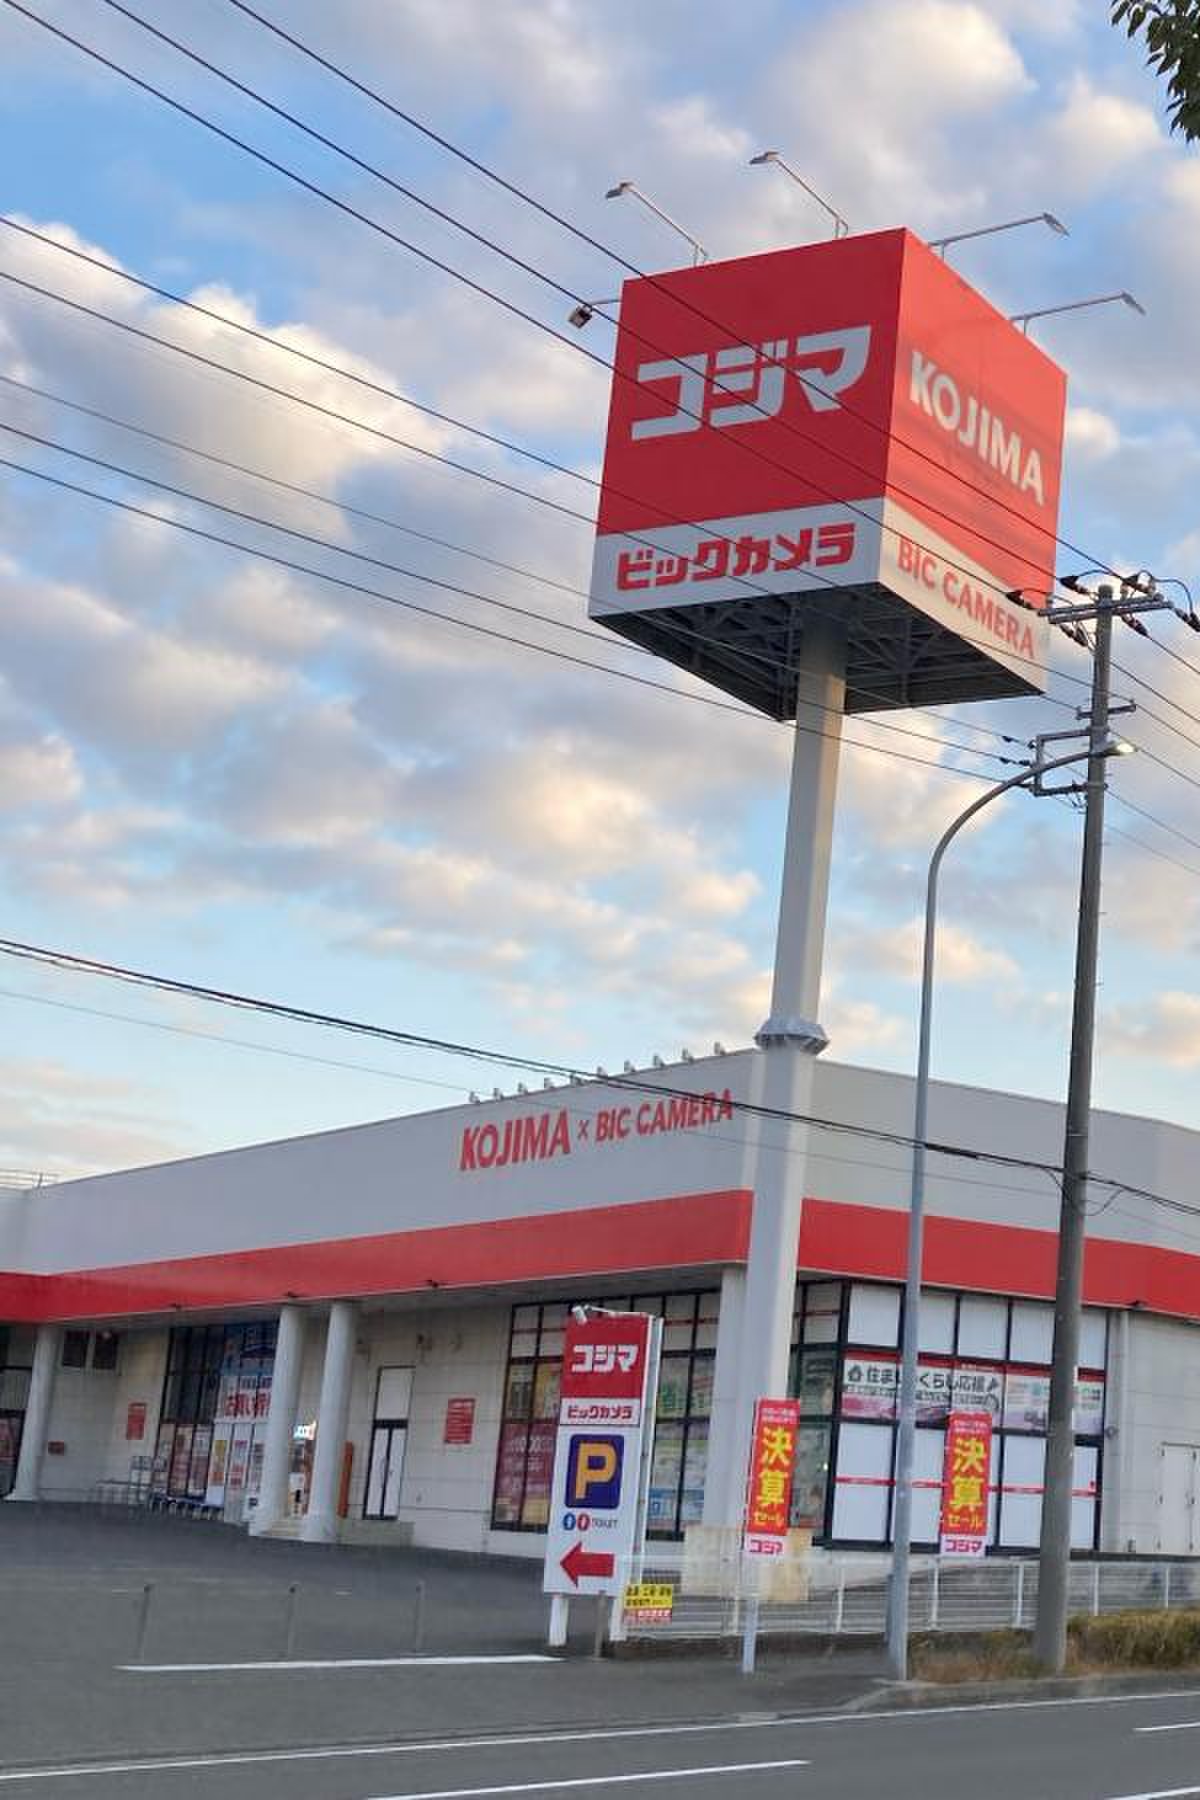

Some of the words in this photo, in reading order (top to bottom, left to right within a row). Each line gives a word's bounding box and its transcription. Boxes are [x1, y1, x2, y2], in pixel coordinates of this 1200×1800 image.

[631, 324, 871, 440] コジマ
[910, 350, 1045, 506] KOJIMA
[616, 523, 856, 591] ビックカメラ
[897, 535, 936, 587] BIC
[943, 570, 1035, 659] CAMERA
[459, 1107, 571, 1171] KOJIMA
[596, 1108, 631, 1142] BIC
[636, 1088, 733, 1135] CAMERA
[571, 1343, 639, 1373] コジマ
[567, 1404, 633, 1420] ビックカメラ
[575, 1442, 617, 1499] P
[755, 1425, 793, 1507] 決算
[950, 1437, 986, 1511] 決算
[945, 1539, 982, 1553] コジマ
